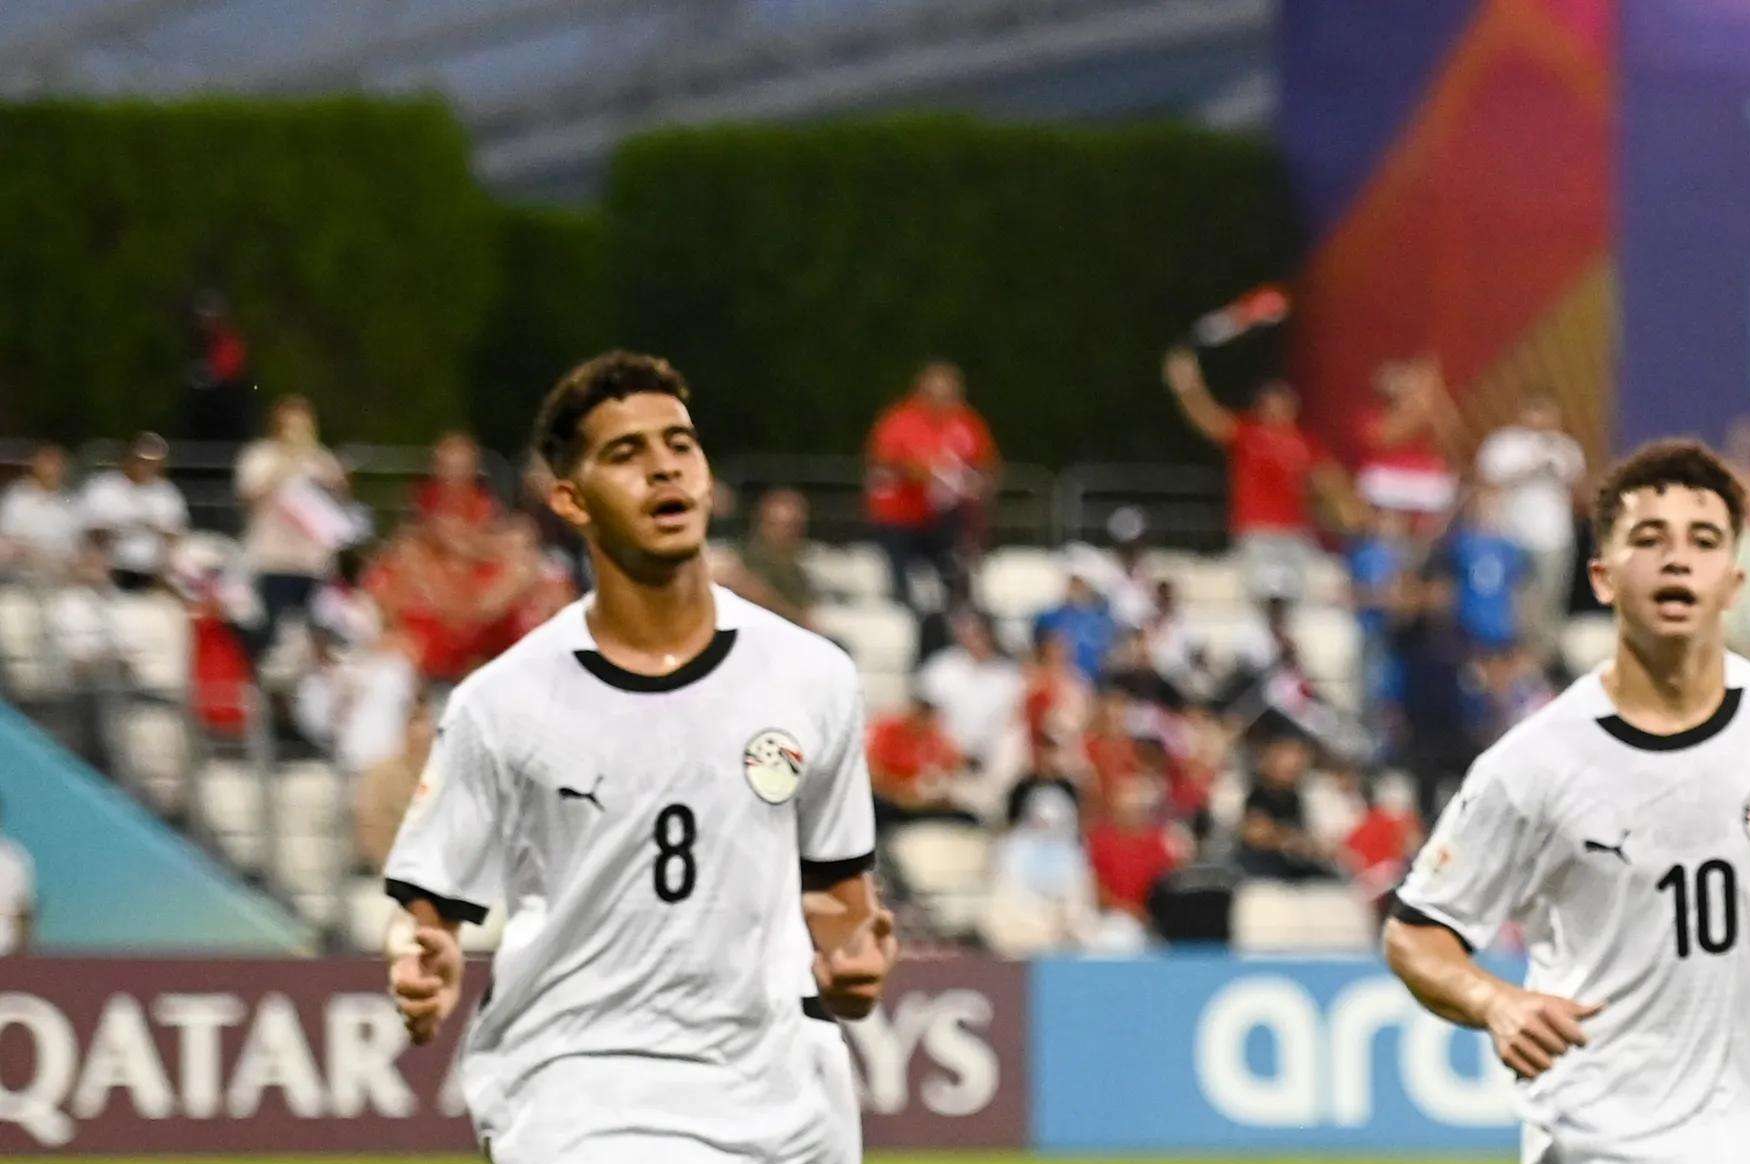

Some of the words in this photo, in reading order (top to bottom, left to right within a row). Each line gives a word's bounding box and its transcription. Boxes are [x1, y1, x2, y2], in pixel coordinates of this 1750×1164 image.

[654, 803, 697, 903] 8
[1656, 858, 1738, 957] 10
[0, 992, 415, 1147] QATAR
